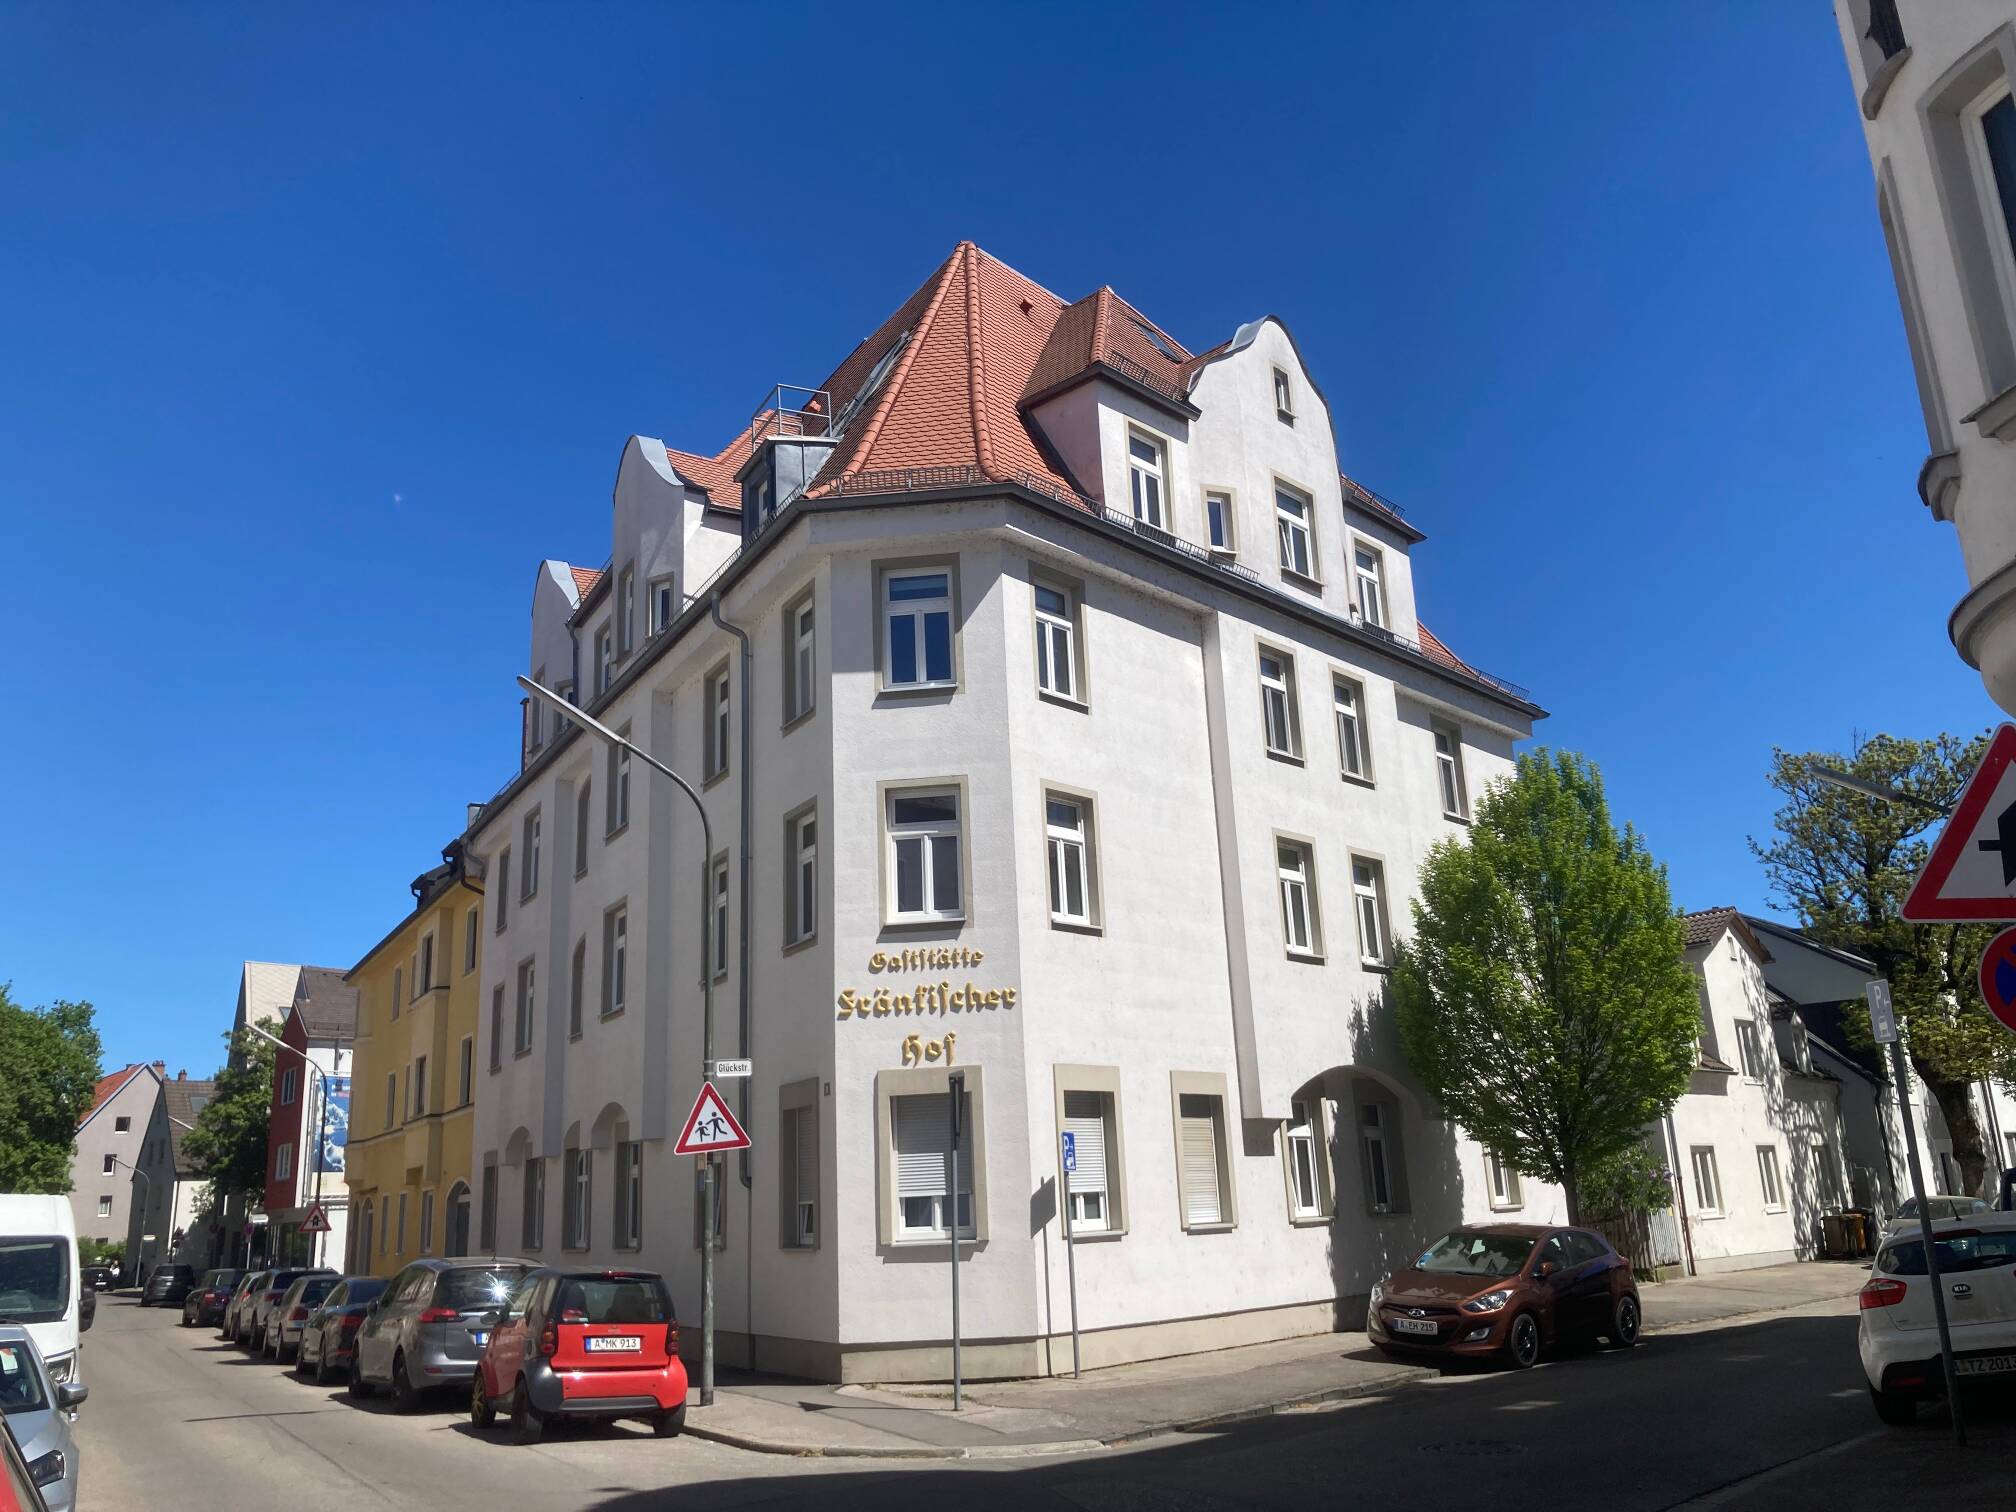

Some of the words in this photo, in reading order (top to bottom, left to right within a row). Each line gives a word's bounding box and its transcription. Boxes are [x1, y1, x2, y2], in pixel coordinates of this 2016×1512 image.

[902, 1030, 957, 1068] Hof
[718, 1063, 750, 1072] Glückstr.
[595, 1338, 601, 1348] A
[605, 1338, 617, 1348] MK
[620, 1338, 637, 1348] 913
